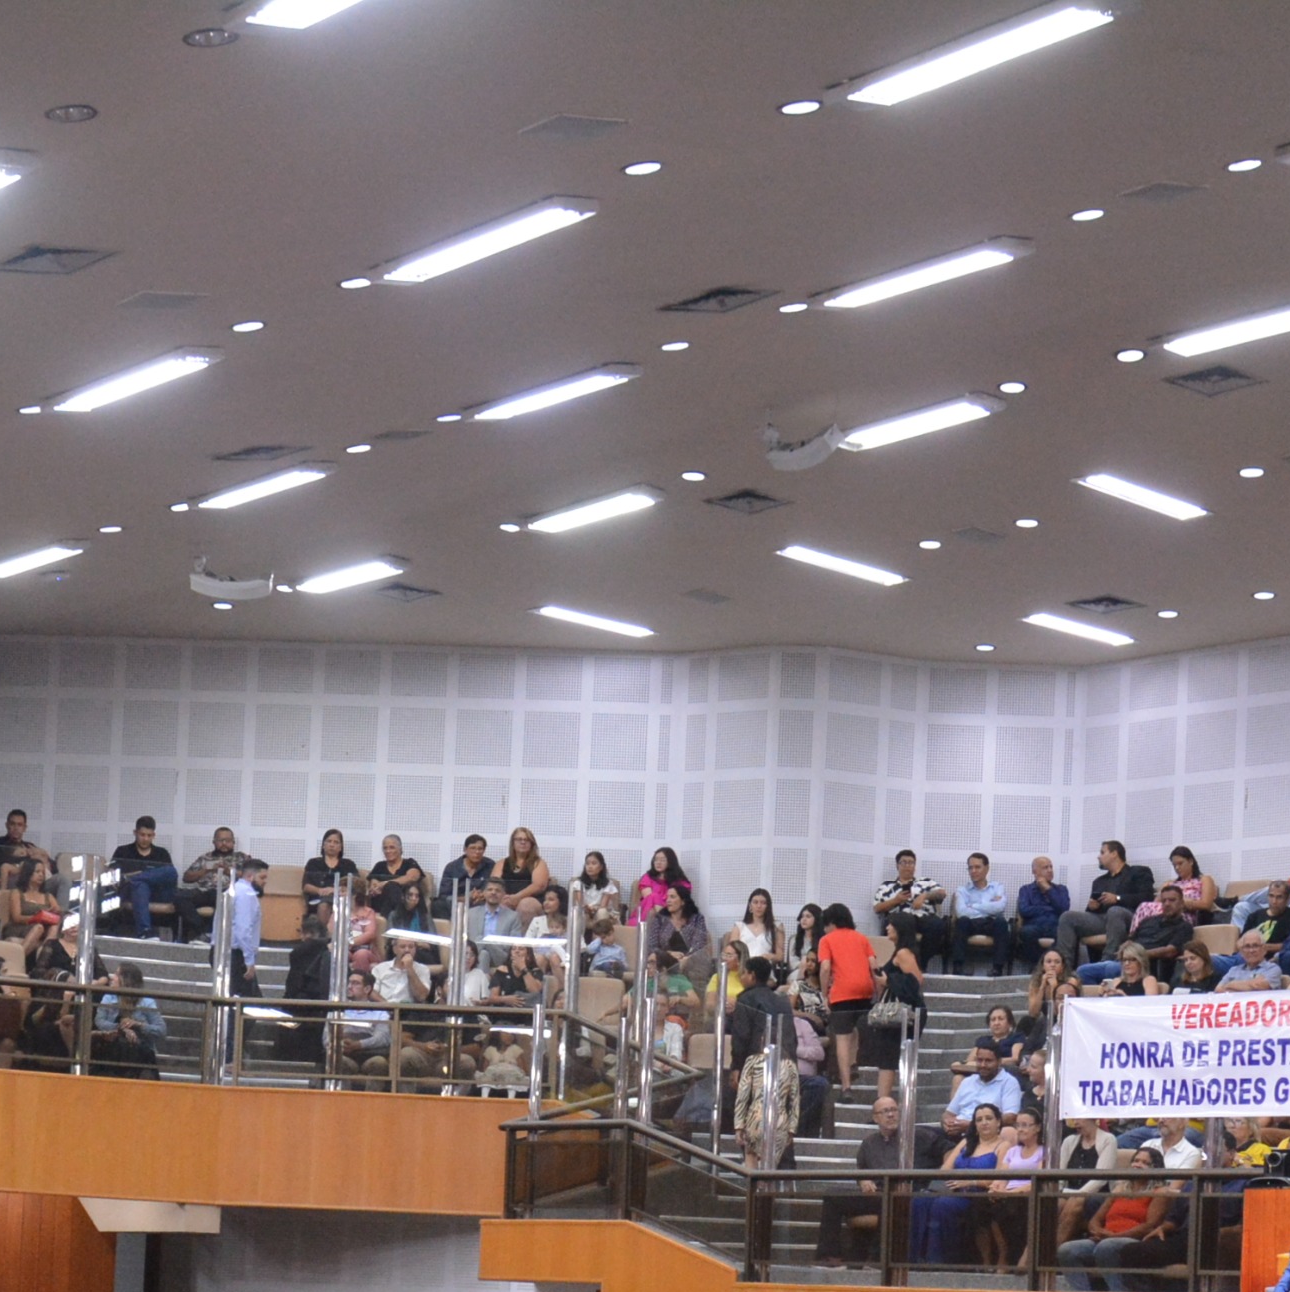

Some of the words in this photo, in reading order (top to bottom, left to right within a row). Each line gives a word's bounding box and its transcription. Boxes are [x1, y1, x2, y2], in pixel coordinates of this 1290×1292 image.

[1101, 1042, 1174, 1068] HONRA
[1183, 1041, 1209, 1066] DE
[1079, 1077, 1266, 1106] TRABALHADORES
